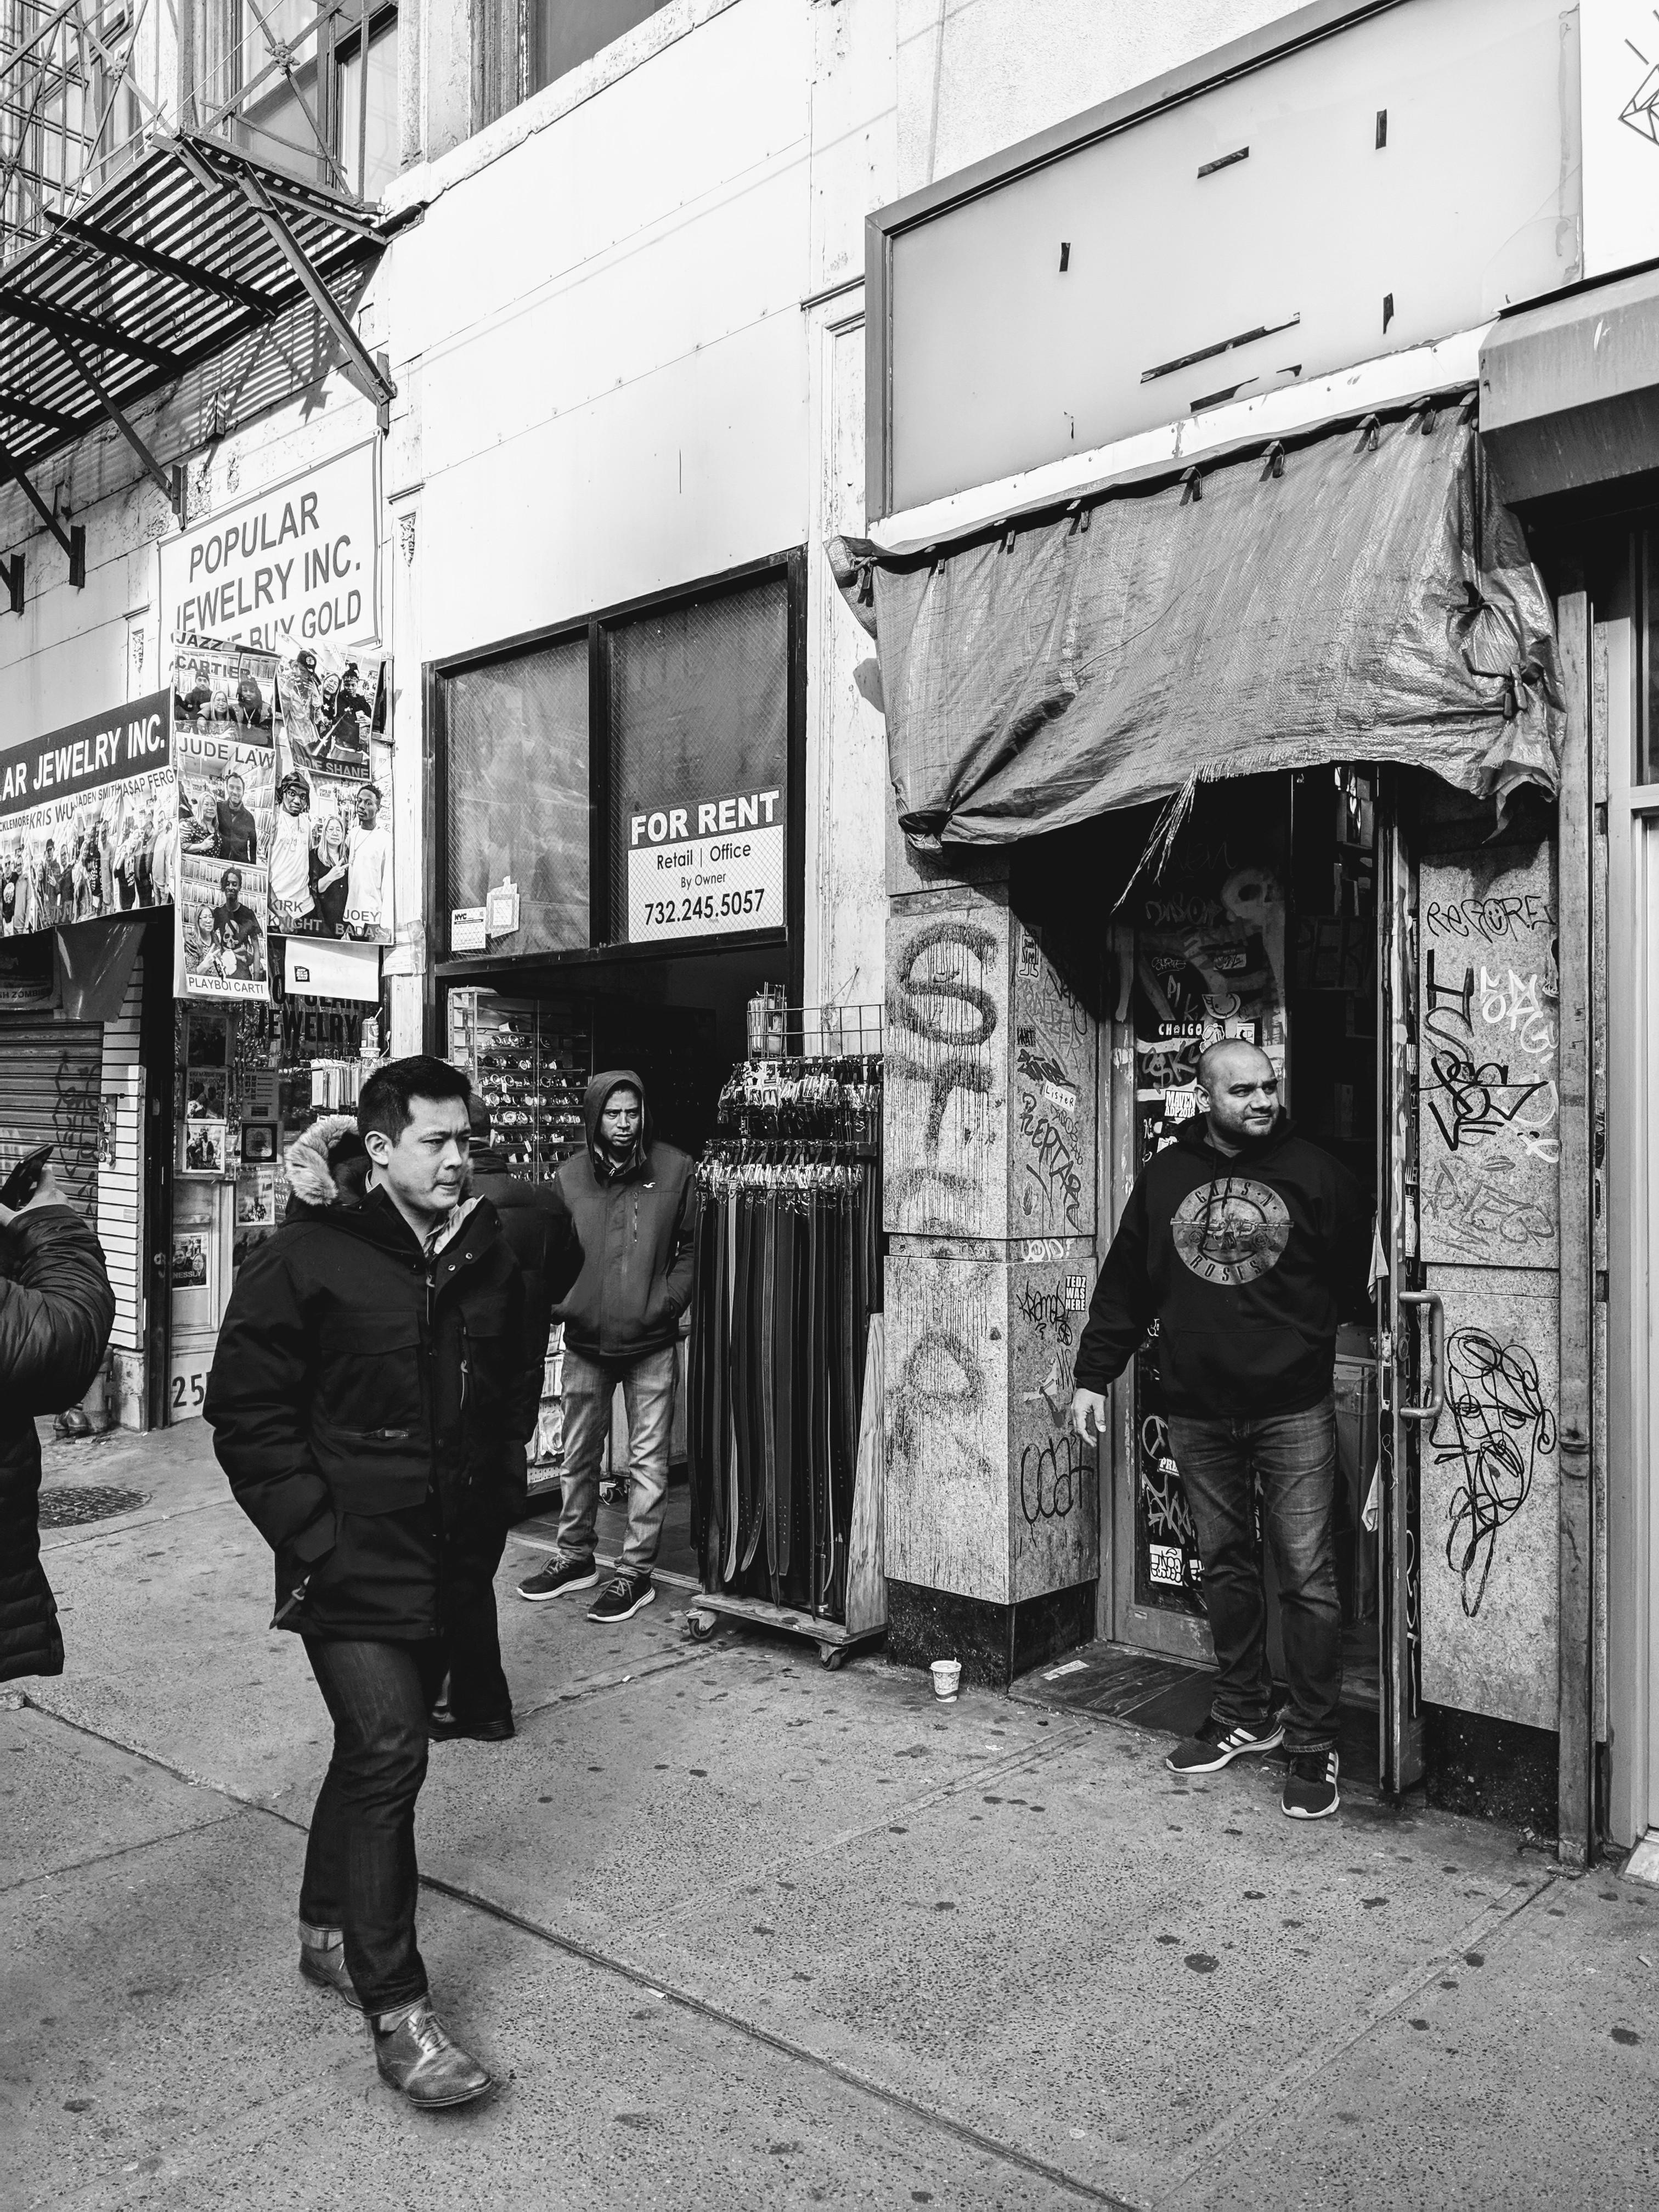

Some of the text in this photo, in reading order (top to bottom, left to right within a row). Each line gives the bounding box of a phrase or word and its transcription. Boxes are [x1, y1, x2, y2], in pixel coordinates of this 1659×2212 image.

[189, 491, 319, 583] POPULAR
[304, 534, 360, 592] INC.
[302, 590, 361, 638] GOLD
[176, 632, 224, 652] JAZZ
[0, 713, 165, 802] AR JEWELRY INC.
[178, 737, 275, 768] JUDE LAW
[148, 769, 174, 789] FERG
[325, 761, 369, 778] SHANE
[74, 792, 97, 809] JADEN
[29, 808, 52, 830] KRIS
[631, 790, 780, 845] FOR RENT
[657, 843, 752, 870] Retail Office
[681, 872, 726, 889] By Owner
[273, 900, 303, 913] KIRK
[343, 909, 379, 922] JOEY
[645, 888, 765, 926] 732.245.5057
[188, 977, 264, 994] PLAYBOI CARTI
[256, 1008, 358, 1042] JEWELRY
[1165, 1091, 1196, 1108] MAVEN
[1066, 1276, 1086, 1288] TEDZ
[1066, 1288, 1085, 1299] WAS
[1065, 1299, 1085, 1311] HERE
[172, 1373, 205, 1408] 25
